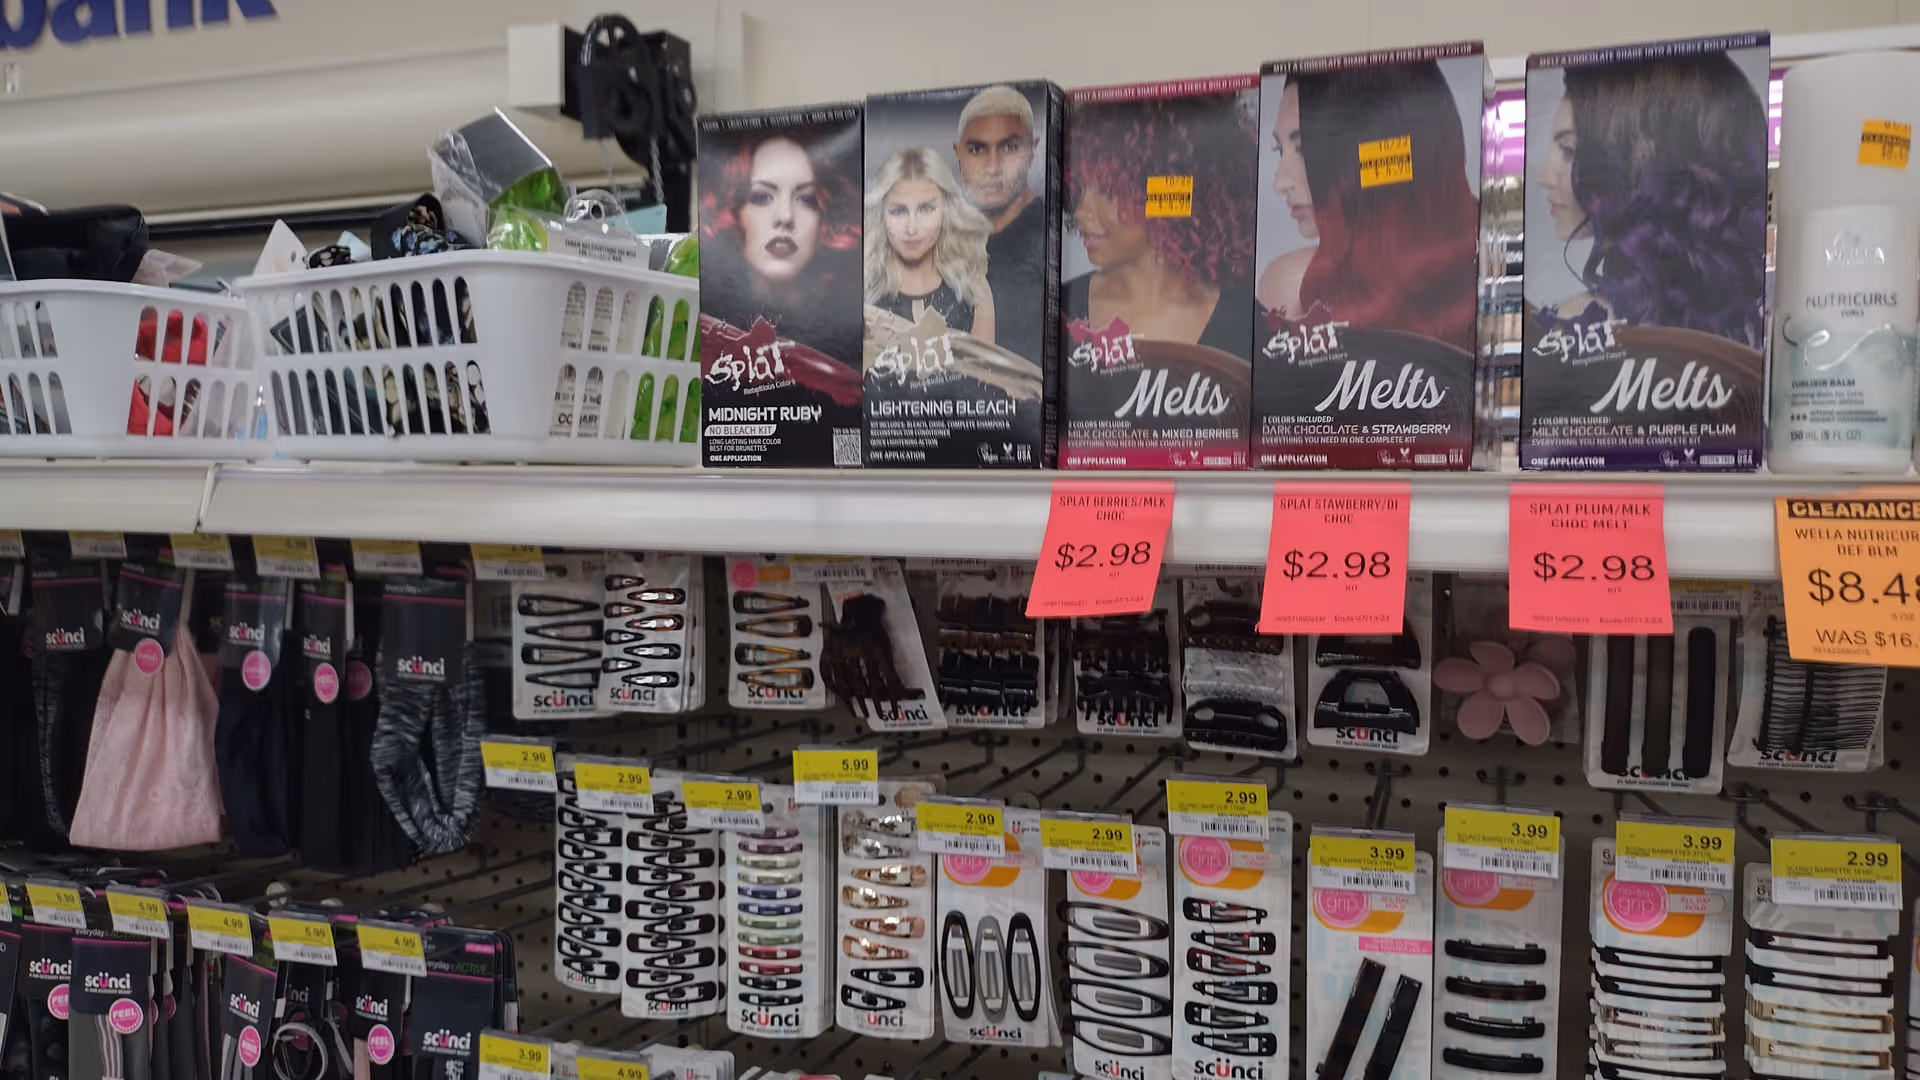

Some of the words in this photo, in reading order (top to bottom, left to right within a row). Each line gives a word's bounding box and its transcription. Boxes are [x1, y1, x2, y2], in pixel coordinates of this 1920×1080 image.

[1806, 292, 1897, 310] NUTRICURLS
[1314, 360, 1447, 412] Melts
[1590, 358, 1733, 414] Melts
[1114, 368, 1230, 418] Melts
[708, 406, 778, 422] MIDNIGHT
[780, 404, 822, 423] RUBY
[870, 400, 953, 416] LIGHTENING
[956, 400, 1016, 416] BLEACH
[1268, 416, 1296, 424] COLORS
[1538, 417, 1568, 426] COLORS
[709, 426, 722, 435] NO
[724, 426, 756, 435] BLEACH
[758, 426, 773, 435] KIT
[1068, 429, 1090, 439] MILK
[1092, 429, 1150, 439] CHOCOLATE
[1162, 429, 1193, 439] MIXED
[1195, 429, 1239, 439] BERRIES
[1262, 424, 1291, 435] DARK
[1294, 424, 1358, 435] CHOCOLATE
[1372, 424, 1451, 435] STRAWBERRY
[1532, 424, 1559, 436] MILK
[1562, 424, 1633, 436] CHOCOLATE
[1650, 424, 1697, 436] PURPLE
[1700, 424, 1736, 436] PLUM
[1304, 436, 1319, 444] YOU
[1320, 436, 1338, 444] NEED
[1340, 436, 1348, 444] IN
[1349, 436, 1364, 444] ONE
[1366, 436, 1403, 444] COMPLETE
[1404, 436, 1416, 444] KIT
[870, 451, 884, 461] ONE
[885, 451, 926, 461] APPLICATION
[1068, 457, 1082, 465] ONE
[1082, 457, 1126, 465] APPLICATION
[1261, 455, 1276, 464] ONE
[1278, 455, 1328, 464] APPLICATION
[1532, 456, 1548, 466] ONE
[1550, 456, 1604, 466] APPLICATION
[1060, 496, 1090, 507] SPLAT
[1093, 496, 1166, 508] BERRIES/MLK
[1280, 498, 1312, 510] SPLAT
[1096, 510, 1126, 521] CHOC
[1530, 503, 1570, 515] SPLAT
[1576, 504, 1650, 516] PLUM/MLK
[1324, 514, 1354, 524] CHOC
[1551, 519, 1588, 529] CHOC
[1593, 519, 1628, 530] MELT
[1794, 528, 1842, 540] WELLA
[1054, 541, 1151, 572] $2.98
[1837, 544, 1862, 556] DEF
[1868, 545, 1898, 558] BLM
[1282, 548, 1390, 582] $2.98
[1533, 552, 1655, 582] $2.98
[1816, 628, 1868, 646] WAS
[522, 752, 546, 763] 2.99
[842, 758, 869, 772] 5.99
[618, 773, 642, 785] 2.99
[726, 789, 752, 801] 2.99
[1225, 791, 1258, 805] 2.99
[966, 812, 995, 826] 2.99
[1092, 828, 1123, 841] 2.99
[1512, 822, 1548, 838] 3.99
[1683, 834, 1722, 850] 3.99
[1370, 846, 1405, 860] 3.99
[1847, 851, 1888, 867] 2.99
[223, 918, 244, 929] 4.99
[518, 1048, 542, 1062] 3.99
[618, 1068, 642, 1080] 4.99
